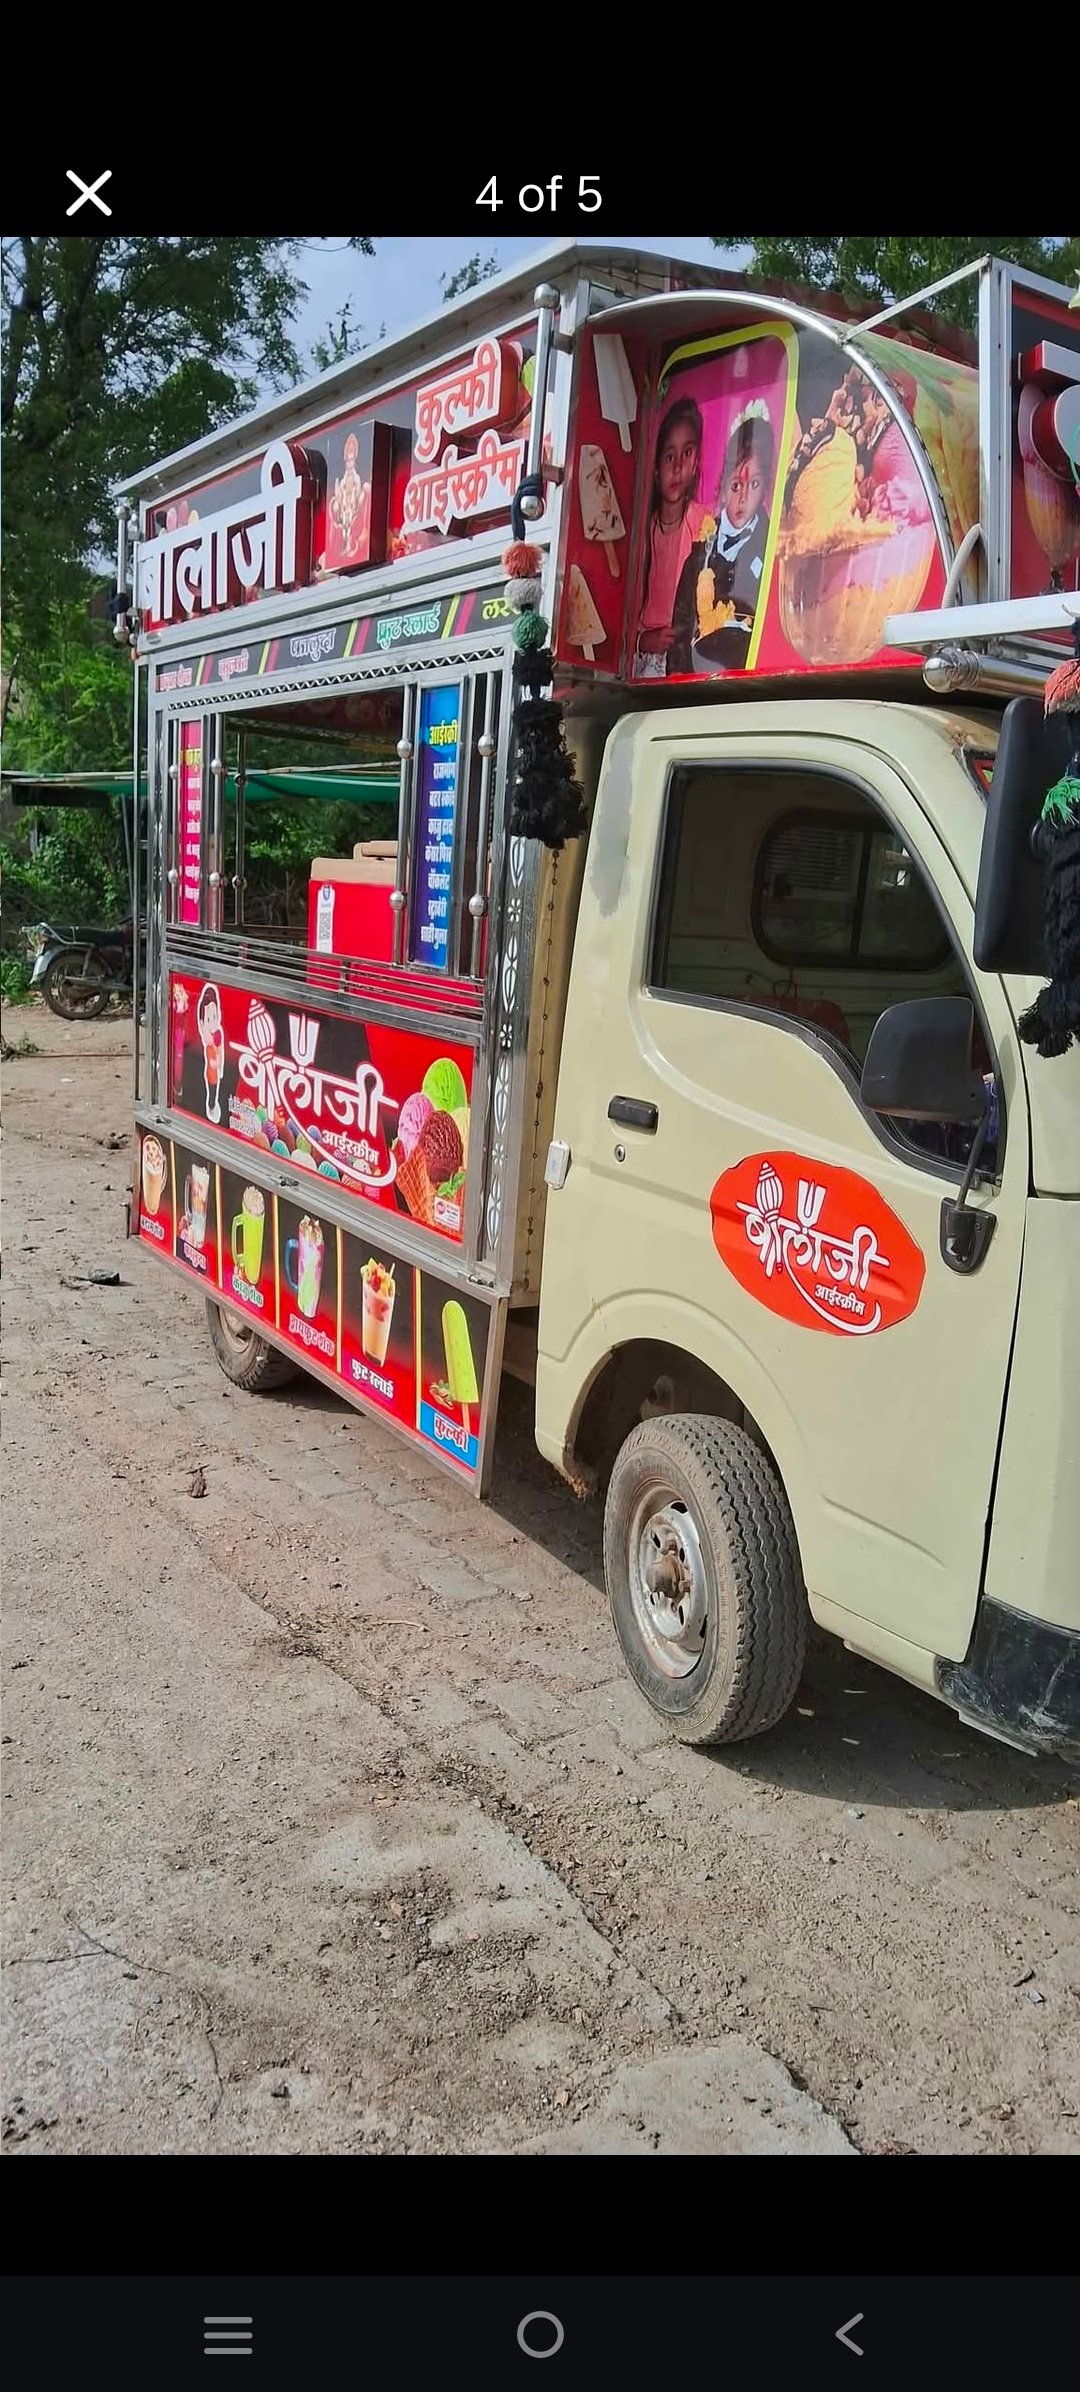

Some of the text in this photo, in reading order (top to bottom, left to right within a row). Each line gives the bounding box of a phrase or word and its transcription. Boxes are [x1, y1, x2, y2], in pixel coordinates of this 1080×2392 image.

[416, 340, 498, 456] कुल्फी
[406, 434, 521, 524] आईस्क्रीम
[138, 440, 302, 623] बालाजी
[290, 627, 337, 662] फालुदा
[229, 1010, 399, 1140] बालाजी
[322, 1129, 380, 1166] आईस्क्रीम
[736, 1175, 890, 1292] बालाजी
[814, 1283, 866, 1316] आईस्क्रीम
